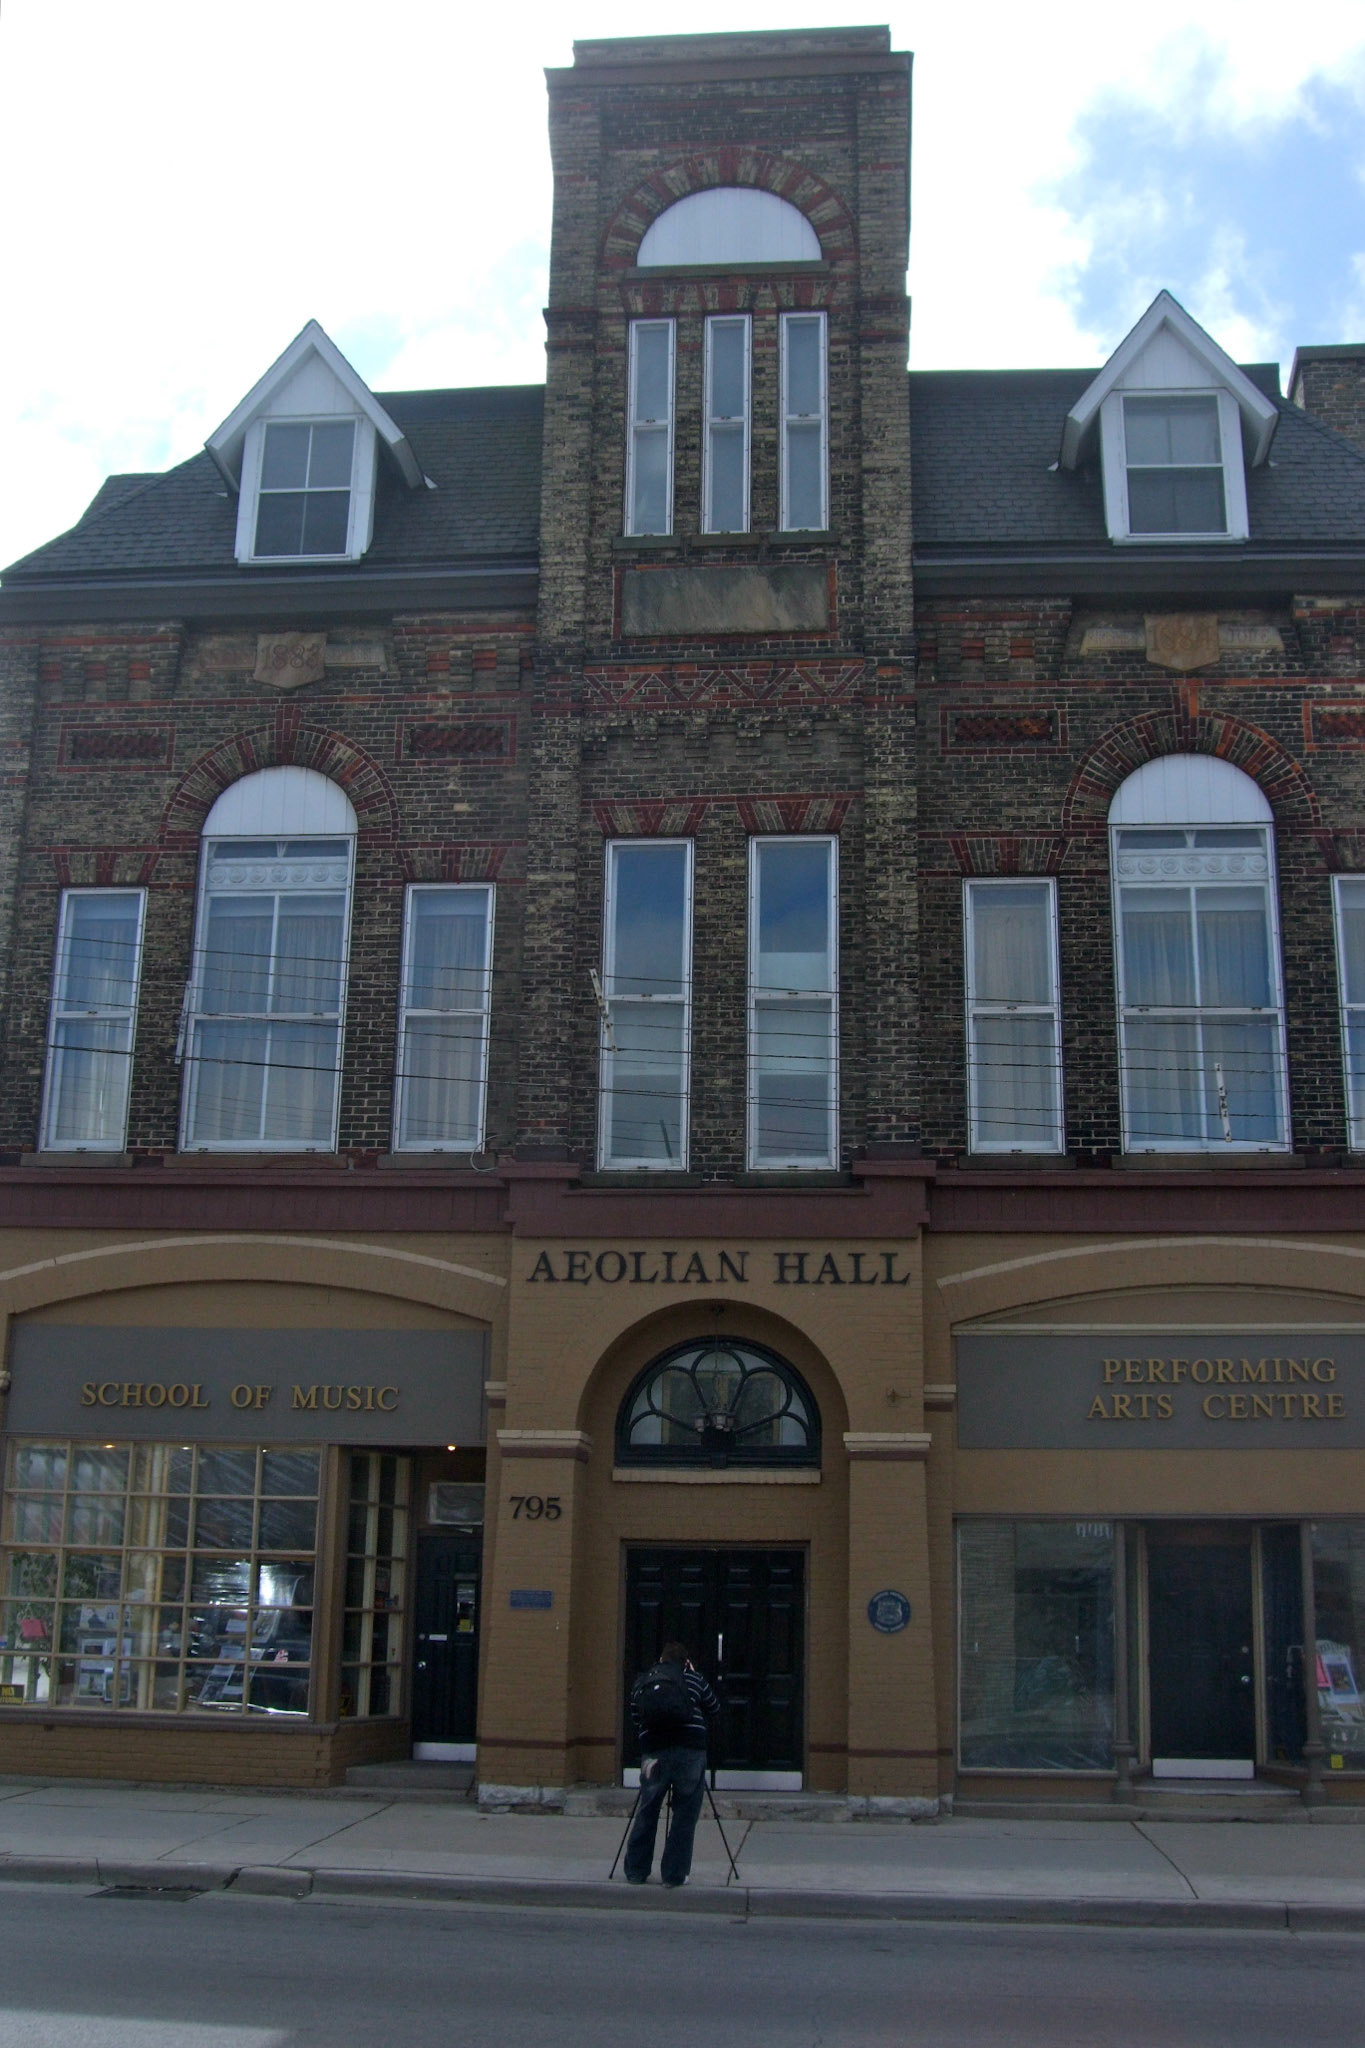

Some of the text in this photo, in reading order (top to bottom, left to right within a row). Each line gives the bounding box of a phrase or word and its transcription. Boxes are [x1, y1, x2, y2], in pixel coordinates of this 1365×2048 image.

[526, 1249, 911, 1285] AEOLIAN HALL
[1102, 1357, 1338, 1384] PERFORMING
[80, 1382, 400, 1411] SCHOOL OF MUSIC
[1086, 1393, 1347, 1420] ARTS CENTRE
[509, 1495, 562, 1520] 795
